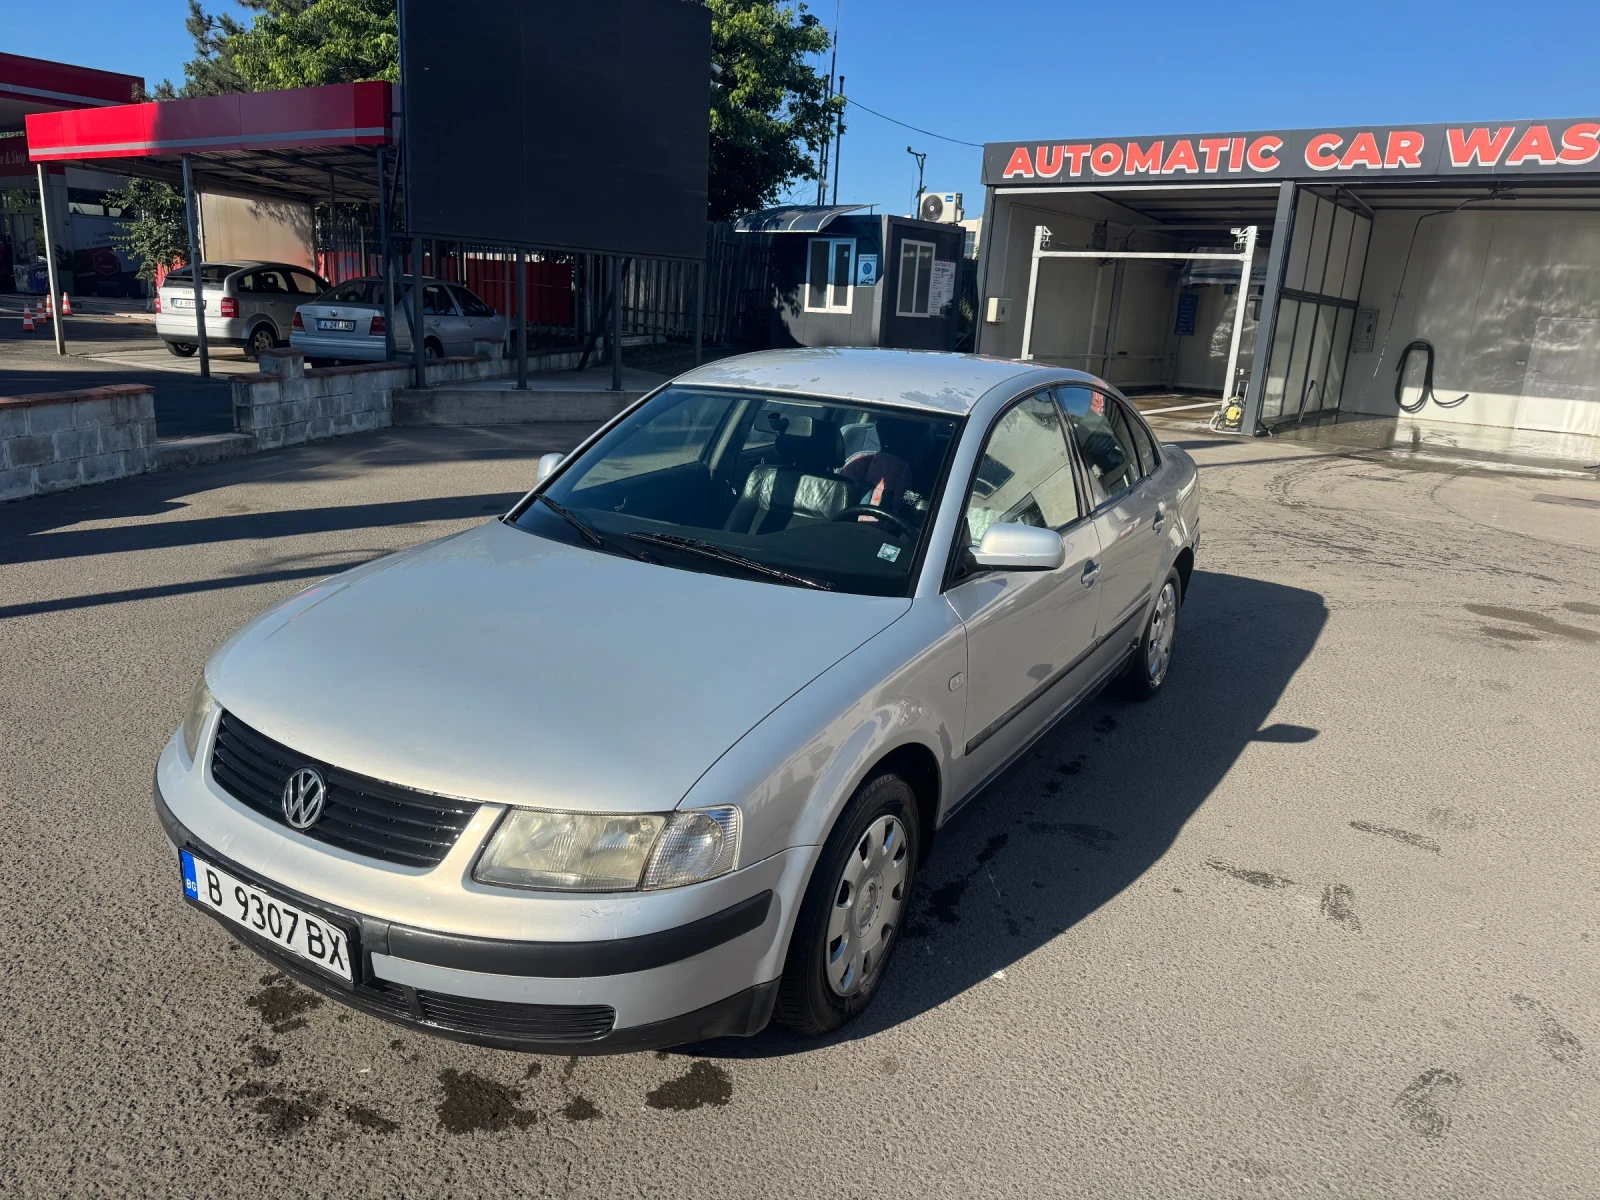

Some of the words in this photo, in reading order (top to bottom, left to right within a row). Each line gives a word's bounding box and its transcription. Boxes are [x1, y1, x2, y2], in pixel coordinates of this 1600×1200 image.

[1003, 136, 1282, 178] AUTOMATIC
[1304, 131, 1424, 169] CAR
[1446, 123, 1600, 168] WAS
[186, 878, 197, 892] BG
[206, 867, 223, 907] B
[234, 885, 299, 945] 9307
[305, 918, 345, 971] BX
